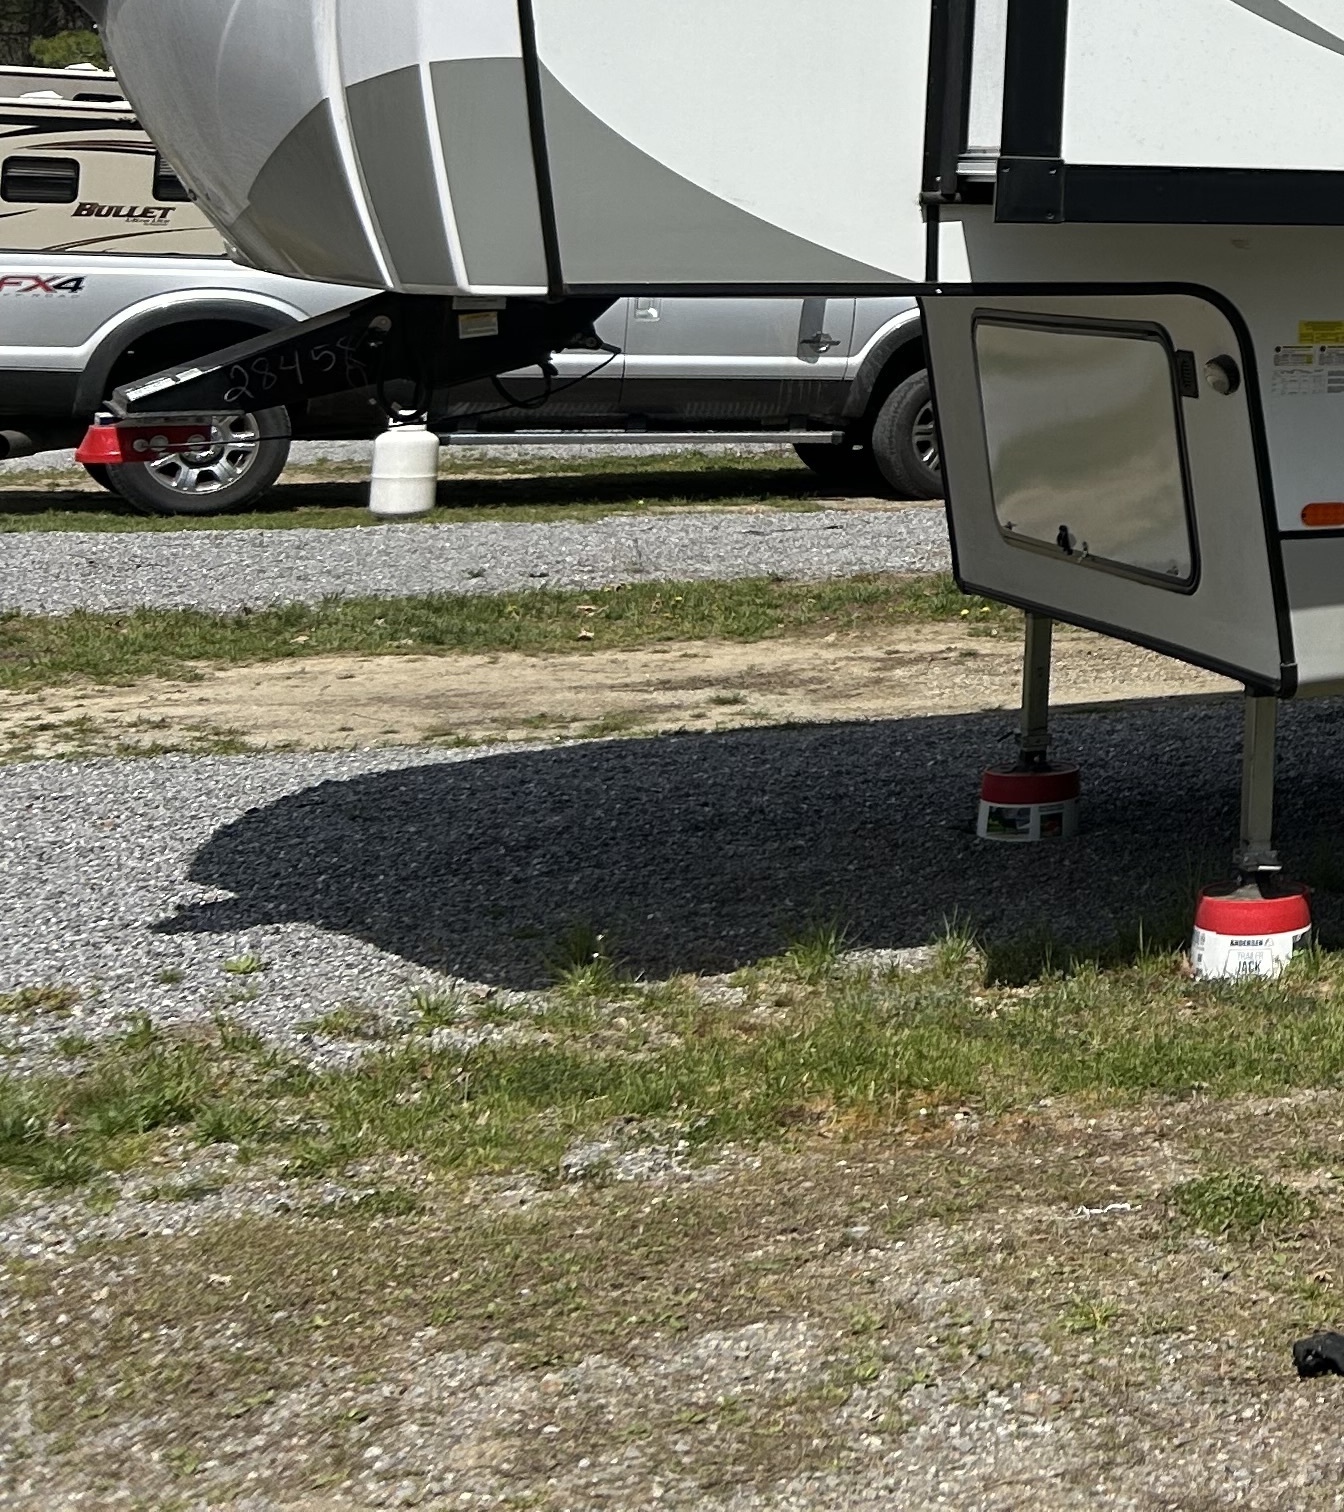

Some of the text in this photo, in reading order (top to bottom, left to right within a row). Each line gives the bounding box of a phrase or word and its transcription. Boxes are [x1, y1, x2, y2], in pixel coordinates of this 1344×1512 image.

[71, 202, 176, 218] BULLET
[0, 275, 86, 293] FX4
[1237, 960, 1261, 975] JACK
